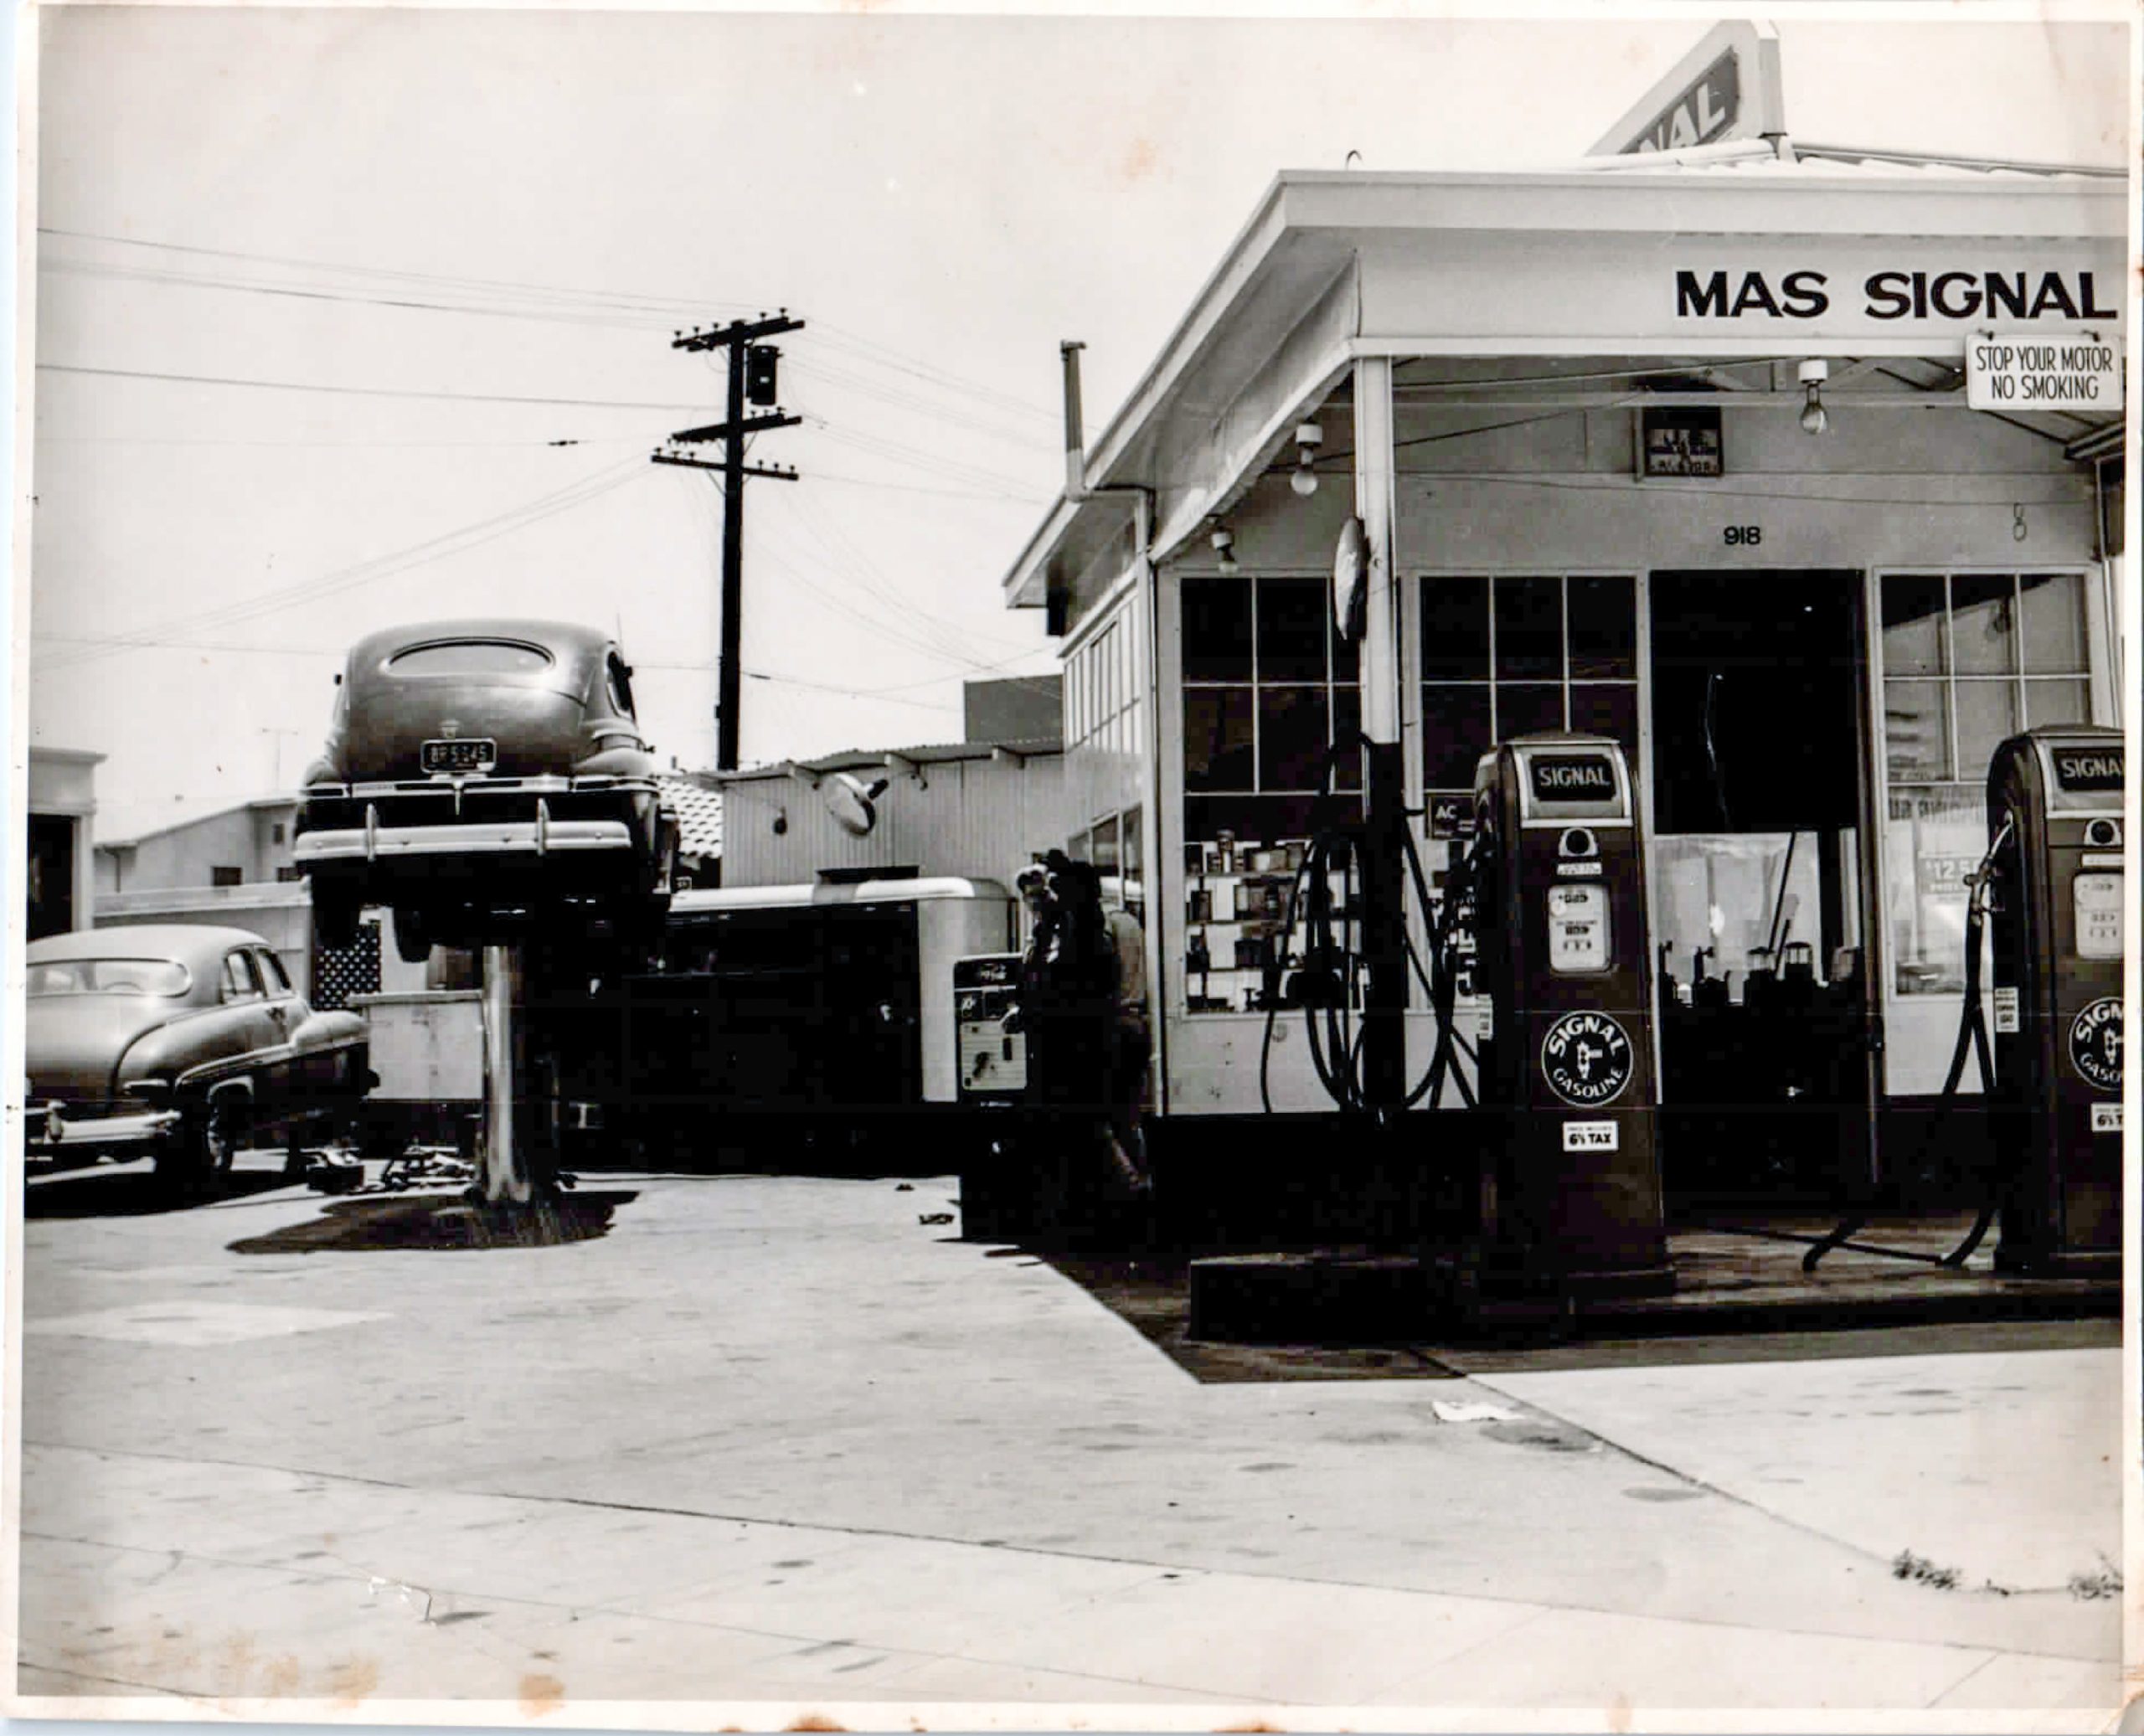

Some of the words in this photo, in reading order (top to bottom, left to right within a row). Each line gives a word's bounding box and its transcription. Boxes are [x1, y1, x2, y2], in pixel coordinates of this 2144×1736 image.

[1676, 270, 1830, 318] MAS
[1865, 270, 2119, 320] SIGNAL
[1976, 346, 2013, 371] STOP
[2017, 346, 2056, 371] YOUR
[2061, 346, 2113, 372] MOTOR
[1992, 375, 2015, 399] NO
[2021, 375, 2099, 400] SMOKING
[1723, 526, 1762, 545] 918
[1538, 765, 1611, 787] SIGNAL
[2060, 758, 2124, 779] SIGNA
[1435, 805, 1457, 819] AC
[1549, 1016, 1625, 1058] SIGNAL
[2080, 1053, 2124, 1083] GASO
[1553, 1067, 1623, 1099] GASOLINE
[1588, 1133, 1611, 1144] TAX
